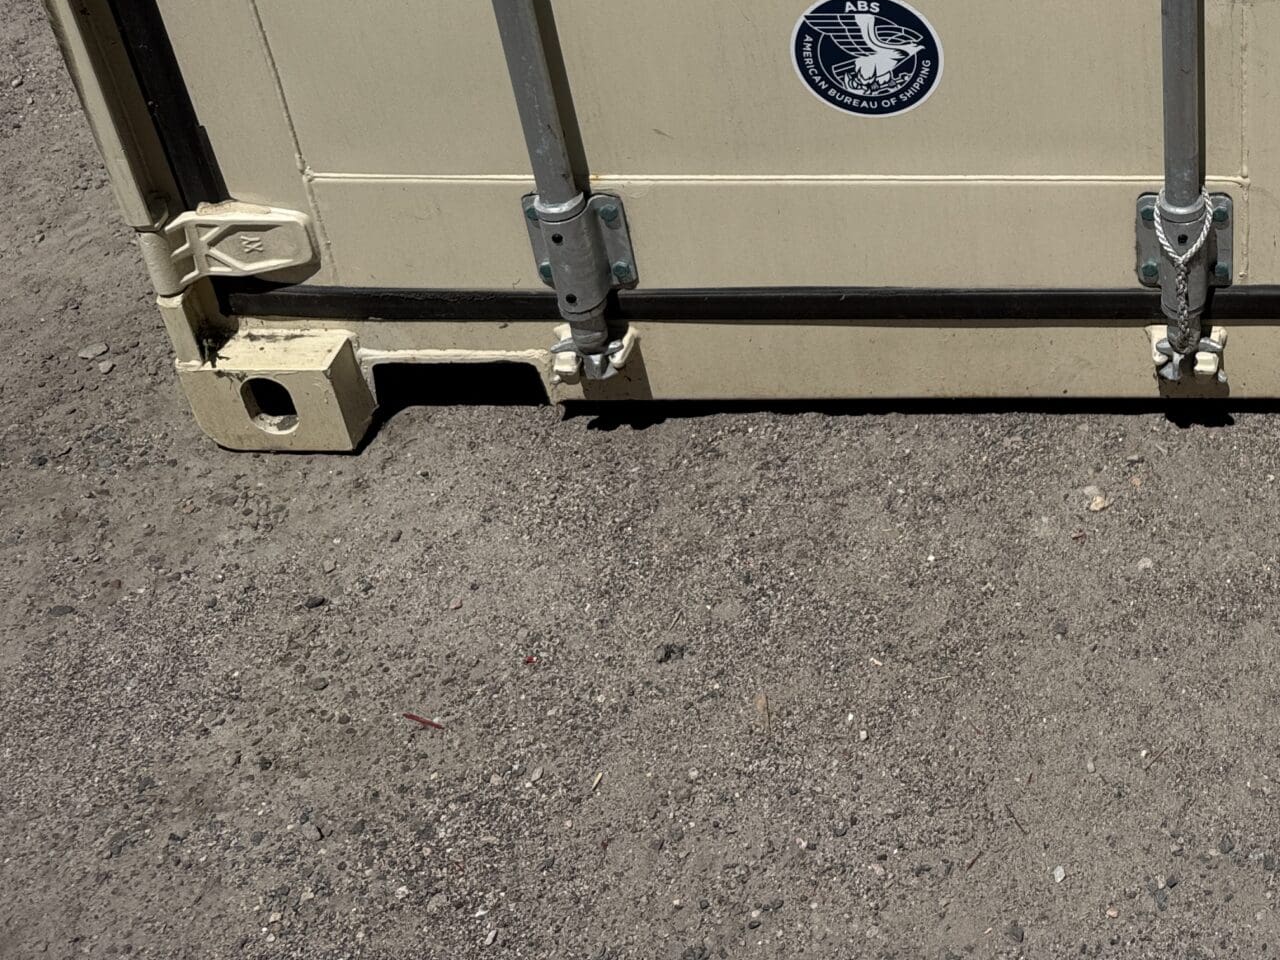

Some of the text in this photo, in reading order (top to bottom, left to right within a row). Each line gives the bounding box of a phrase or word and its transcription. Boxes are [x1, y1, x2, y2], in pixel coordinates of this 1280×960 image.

[845, 1, 880, 13] ABS
[802, 34, 931, 109] AMERICAN BUREAU OF SHIPPING
